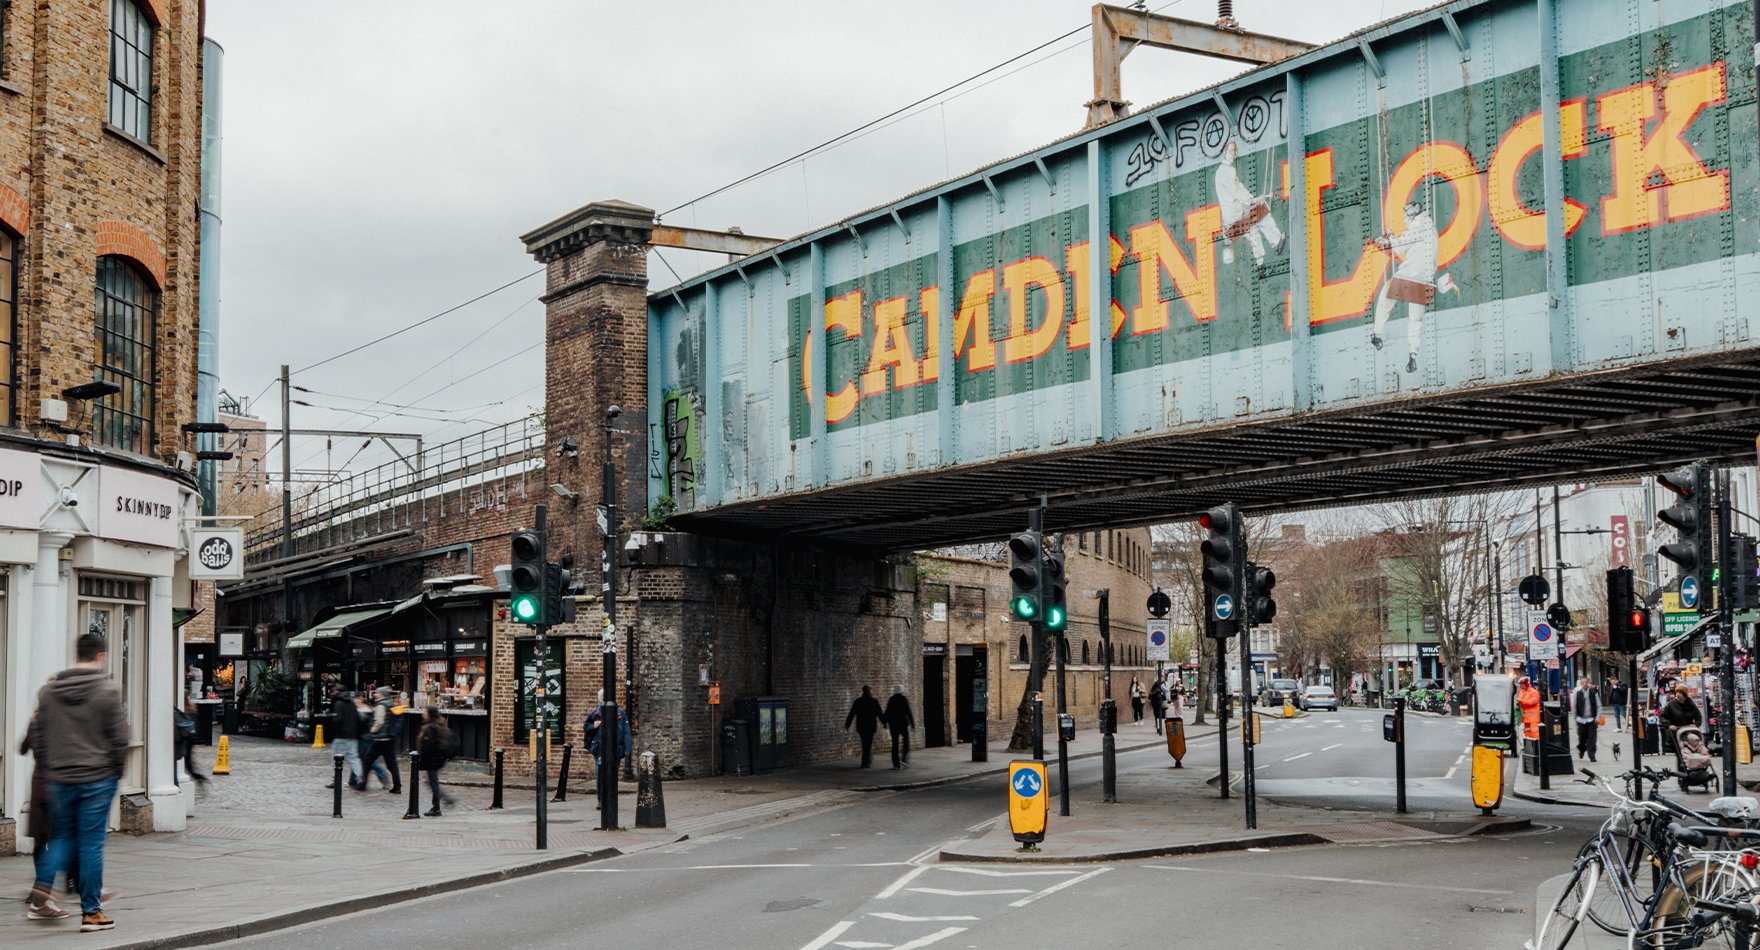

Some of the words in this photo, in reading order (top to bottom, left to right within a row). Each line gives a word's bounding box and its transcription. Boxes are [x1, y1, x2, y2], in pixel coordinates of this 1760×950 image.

[802, 204, 1223, 424] CAMDEN
[1280, 59, 1731, 331] LOCK
[0, 479, 23, 496] DIP
[117, 496, 172, 519] SKINNYDIP
[204, 539, 228, 556] odd
[201, 552, 231, 567] balls
[1665, 624, 1683, 632] OPEN
